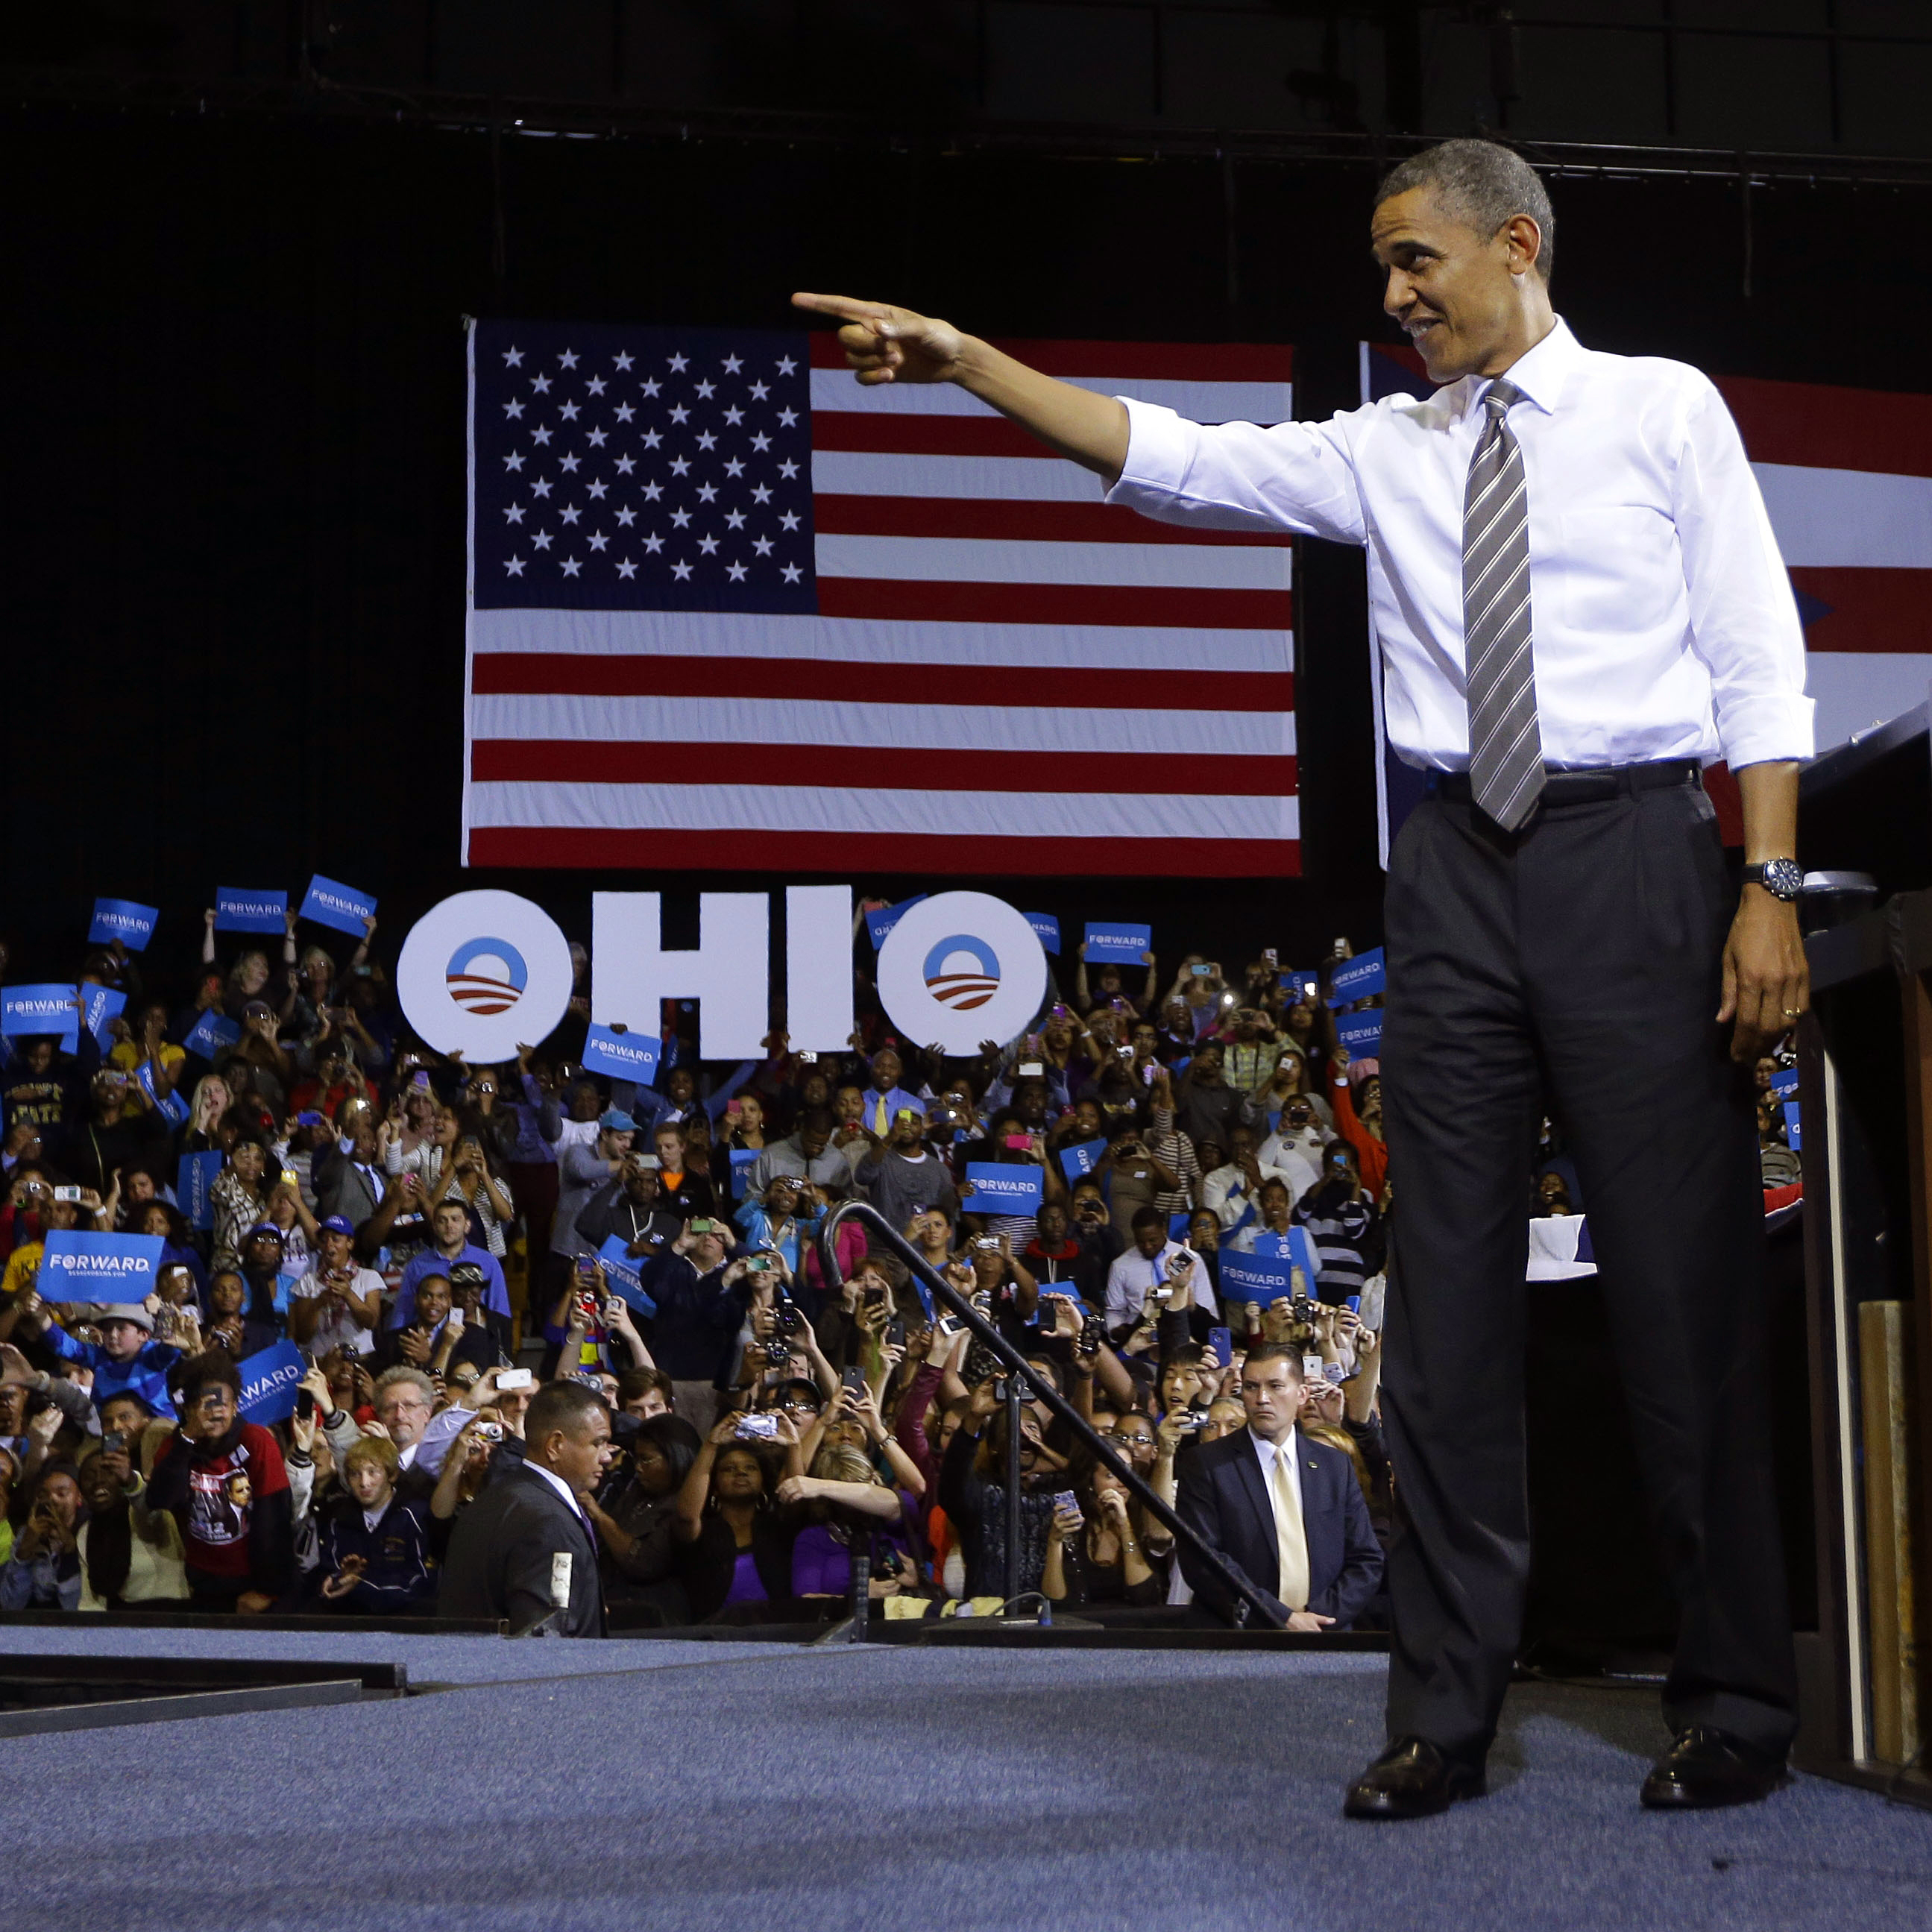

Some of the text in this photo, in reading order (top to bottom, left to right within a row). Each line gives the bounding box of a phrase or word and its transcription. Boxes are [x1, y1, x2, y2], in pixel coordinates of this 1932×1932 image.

[220, 901, 281, 915] FORWARD
[1089, 934, 1145, 947] FORWARD
[397, 884, 1048, 1064] OHIO
